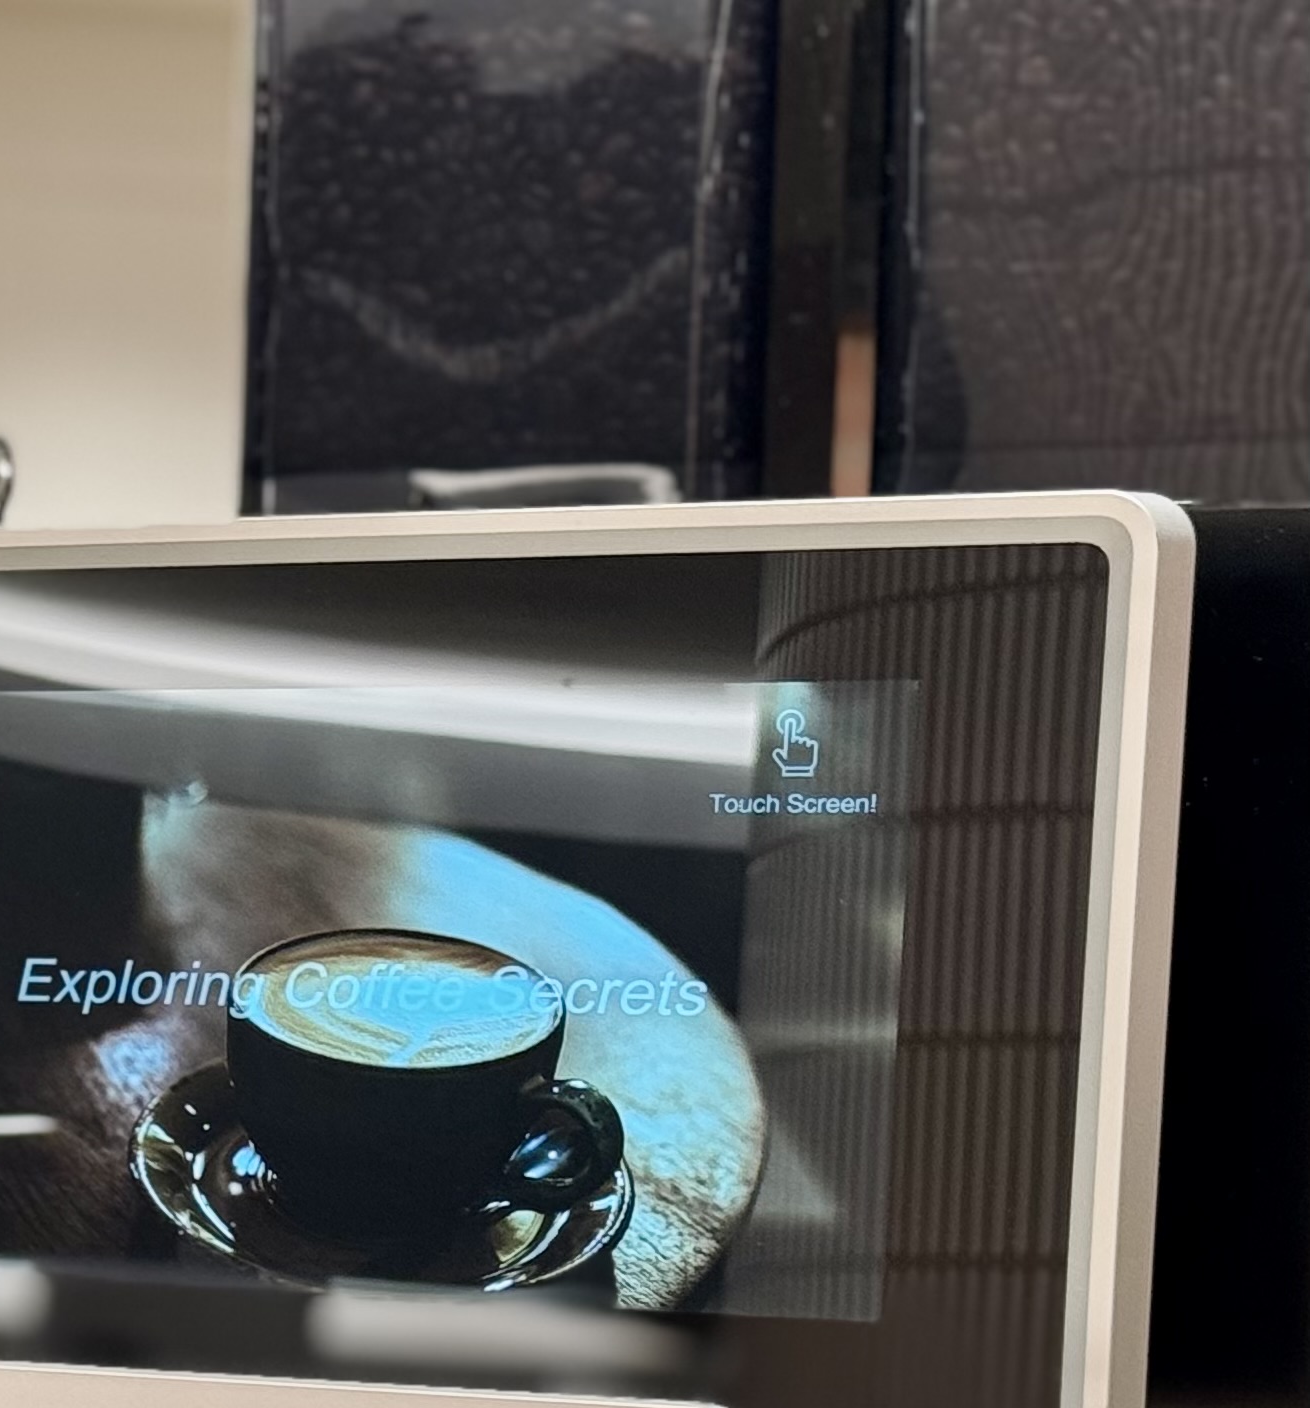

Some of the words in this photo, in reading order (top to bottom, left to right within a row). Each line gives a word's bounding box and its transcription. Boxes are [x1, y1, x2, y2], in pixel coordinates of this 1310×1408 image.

[709, 793, 779, 814] Touch
[787, 793, 877, 814] Screen!
[17, 956, 265, 1020] Exploring
[285, 961, 465, 1014] Coffee
[491, 964, 709, 1018] Secrets
